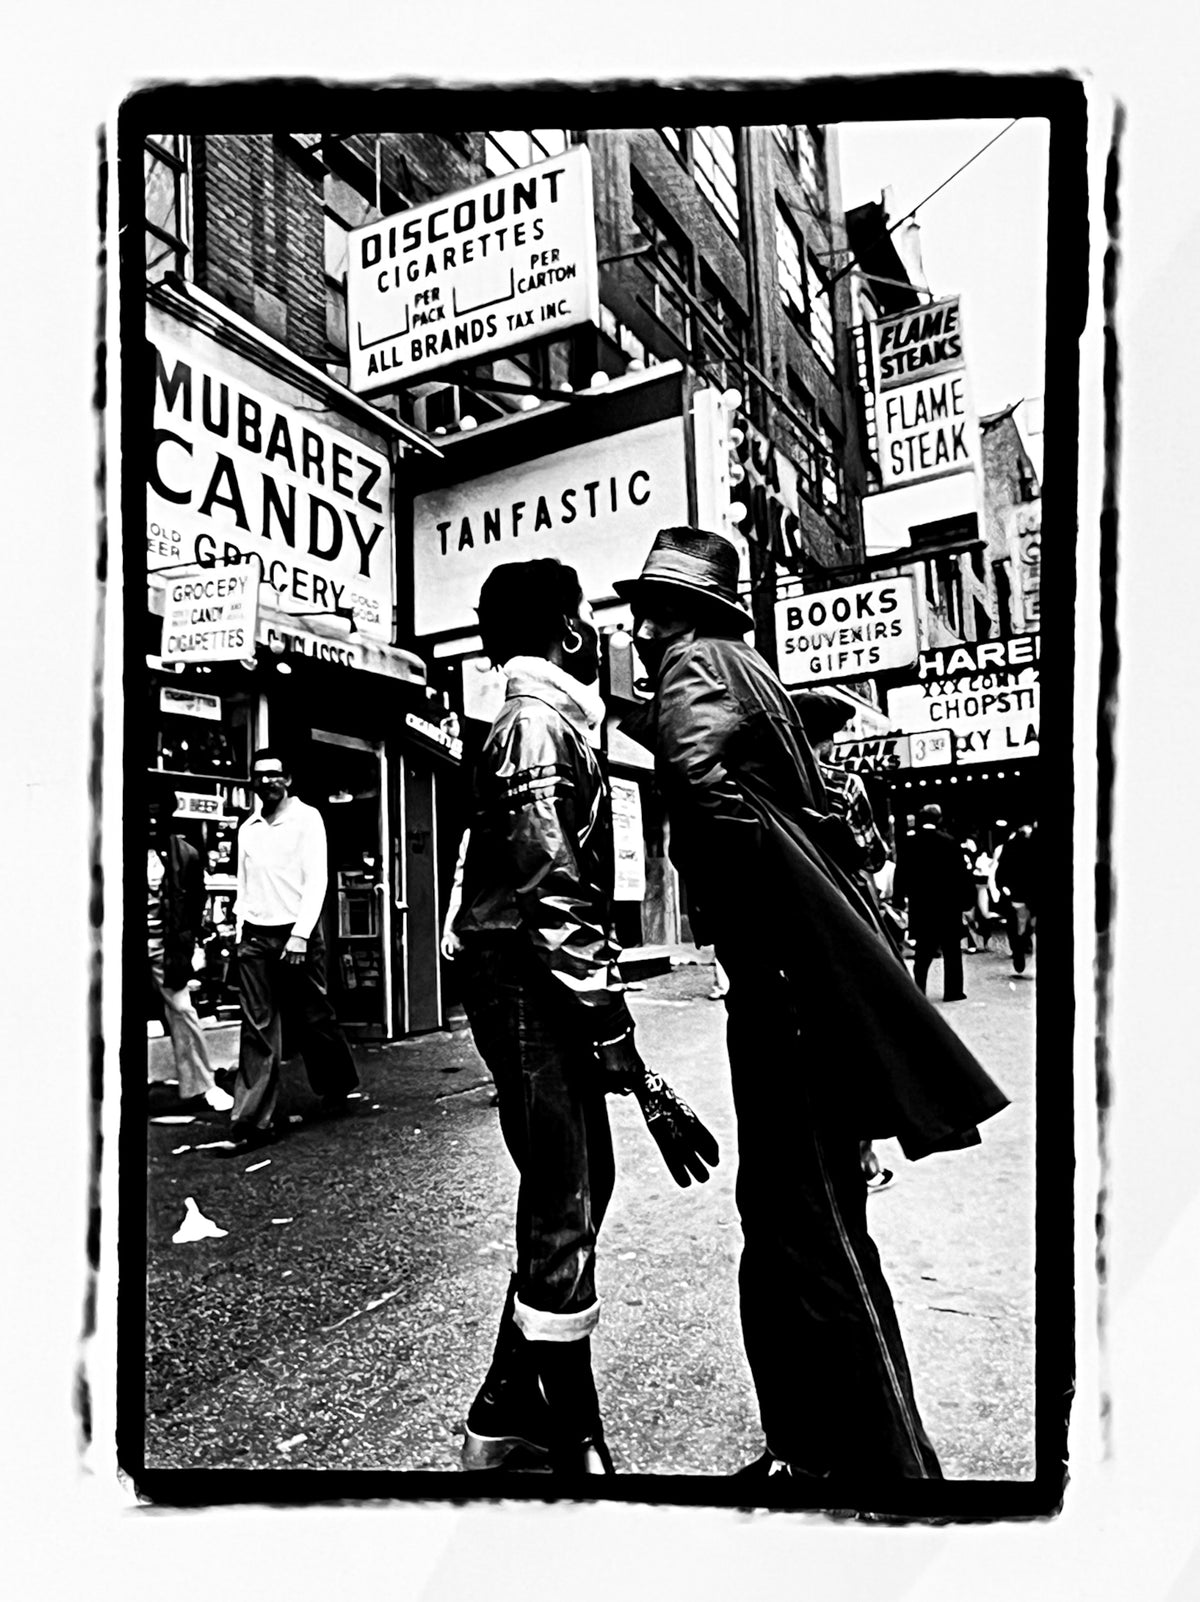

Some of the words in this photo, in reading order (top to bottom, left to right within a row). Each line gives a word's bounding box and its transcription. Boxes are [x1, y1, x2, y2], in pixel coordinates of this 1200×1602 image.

[362, 169, 566, 269] DISCOUNT
[378, 218, 545, 293] CIGARETTES
[517, 263, 577, 294] CARTON
[530, 248, 560, 270] PER
[412, 305, 446, 329] PACK
[414, 287, 440, 307] PER
[368, 346, 403, 376] ALL
[411, 314, 498, 362] BRANDS
[506, 309, 535, 332] TAX
[879, 303, 960, 355] FLAME
[880, 334, 962, 380] STEAKS
[886, 378, 965, 434] FLAME
[154, 348, 383, 514] MUBAREZ
[891, 422, 969, 476] STEAK
[145, 428, 385, 578] CANDY
[436, 469, 651, 556] TANFASTIC
[172, 575, 248, 603] GROCERY
[787, 588, 898, 631] BOOKS
[810, 646, 880, 674] GIFTS
[918, 635, 1040, 679] HARE
